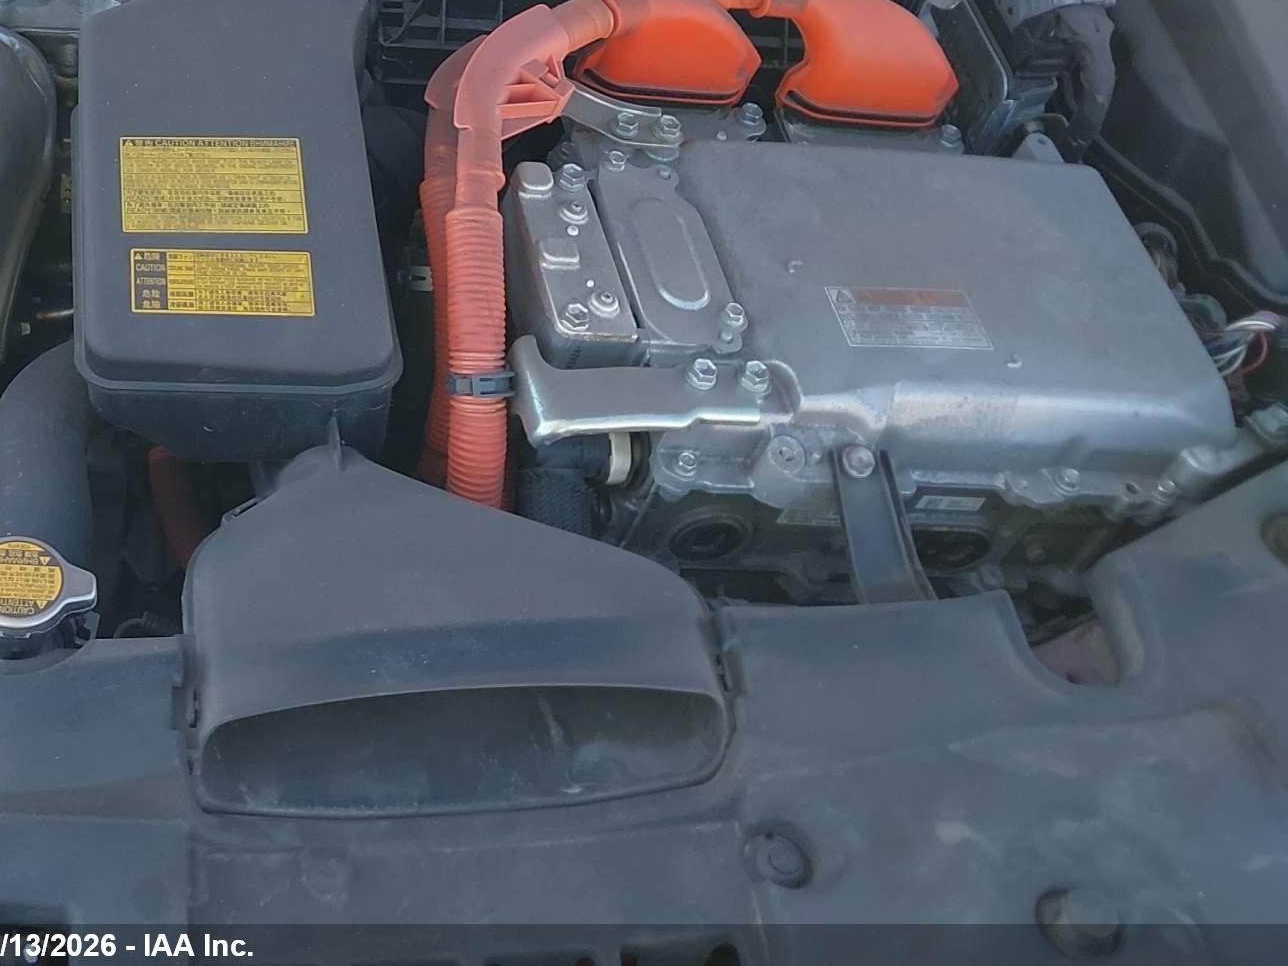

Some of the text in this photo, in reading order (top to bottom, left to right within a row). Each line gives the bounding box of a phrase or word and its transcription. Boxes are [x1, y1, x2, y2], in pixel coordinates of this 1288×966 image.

[155, 139, 196, 147] CAUTION
[198, 139, 249, 147] ATTENTION
[135, 263, 165, 271] CAUTION
[136, 277, 166, 285] ATTENTION
